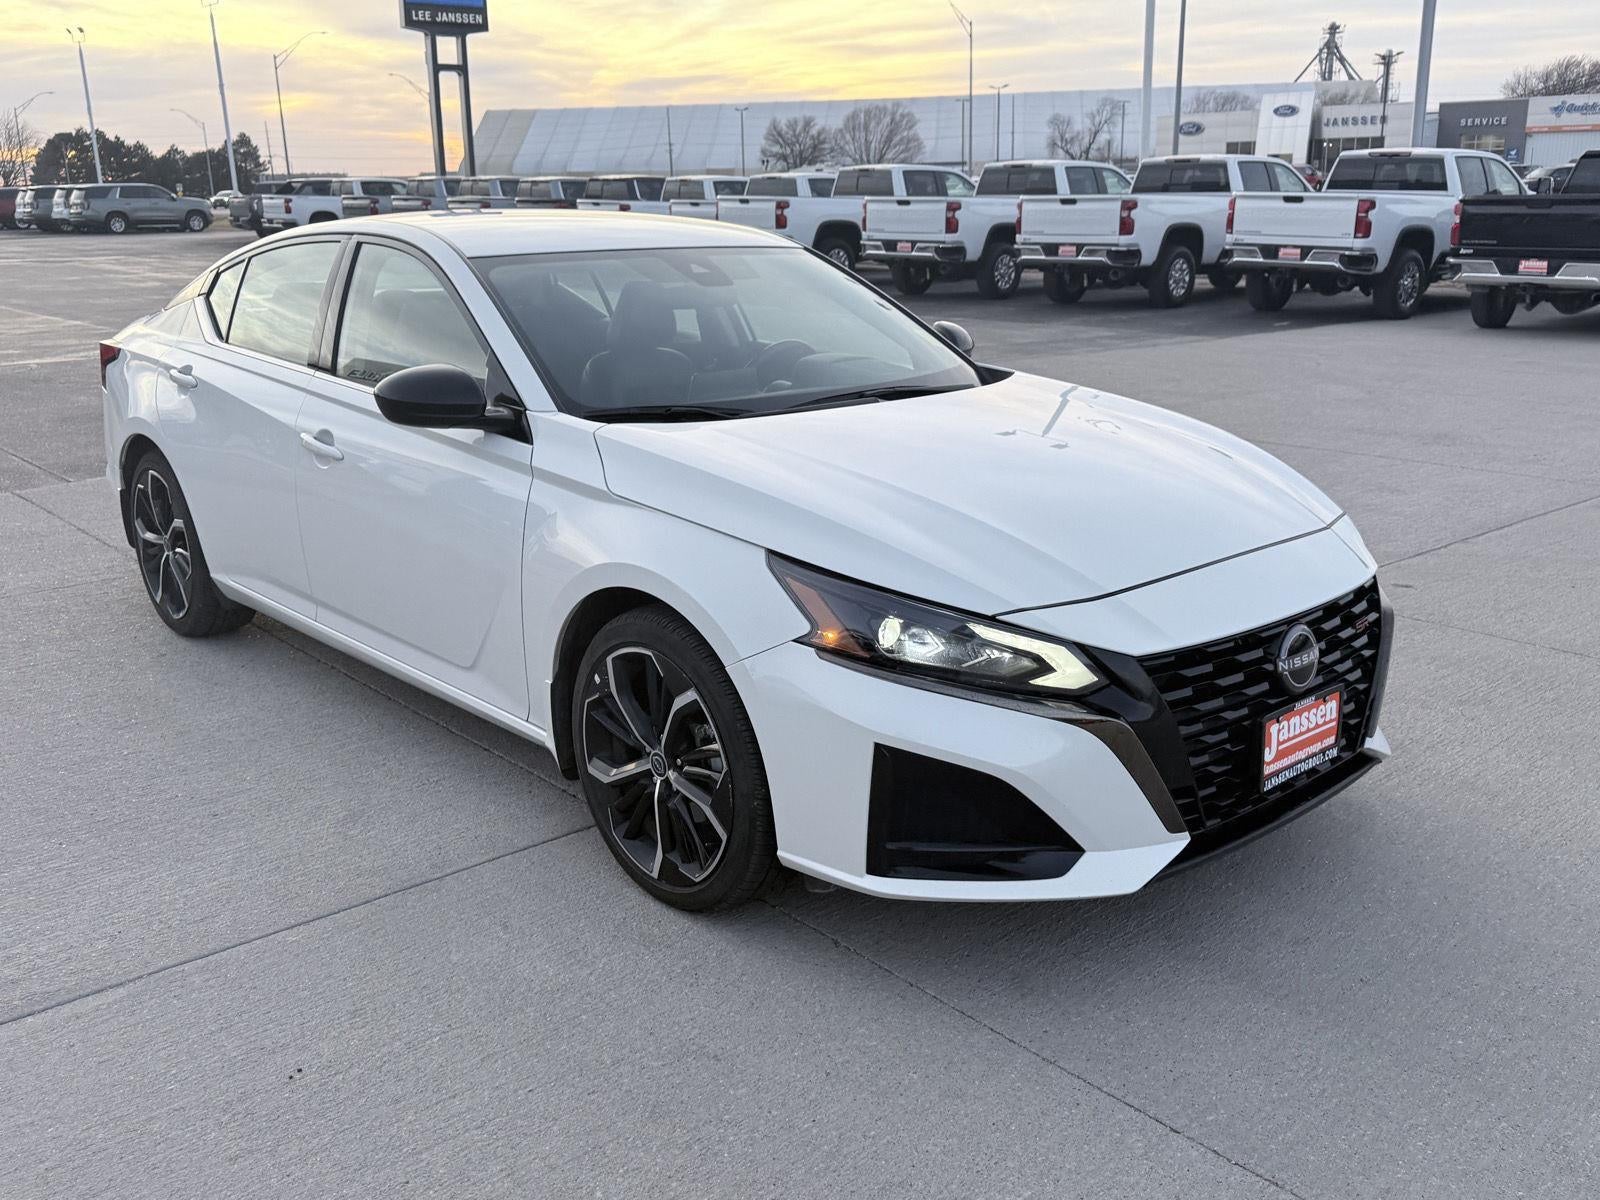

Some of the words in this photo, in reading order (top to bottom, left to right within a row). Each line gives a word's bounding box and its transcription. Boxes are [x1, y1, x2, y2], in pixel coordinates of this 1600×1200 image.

[412, 10, 431, 21] LEE
[436, 12, 482, 24] JANSSEN
[1323, 115, 1388, 128] JANSSEN
[1460, 116, 1507, 126] SERVICE
[1278, 648, 1318, 672] NISSAN
[1264, 700, 1337, 762] Janssen
[1264, 747, 1338, 792] JANSSENAUTOGROUP.COM
